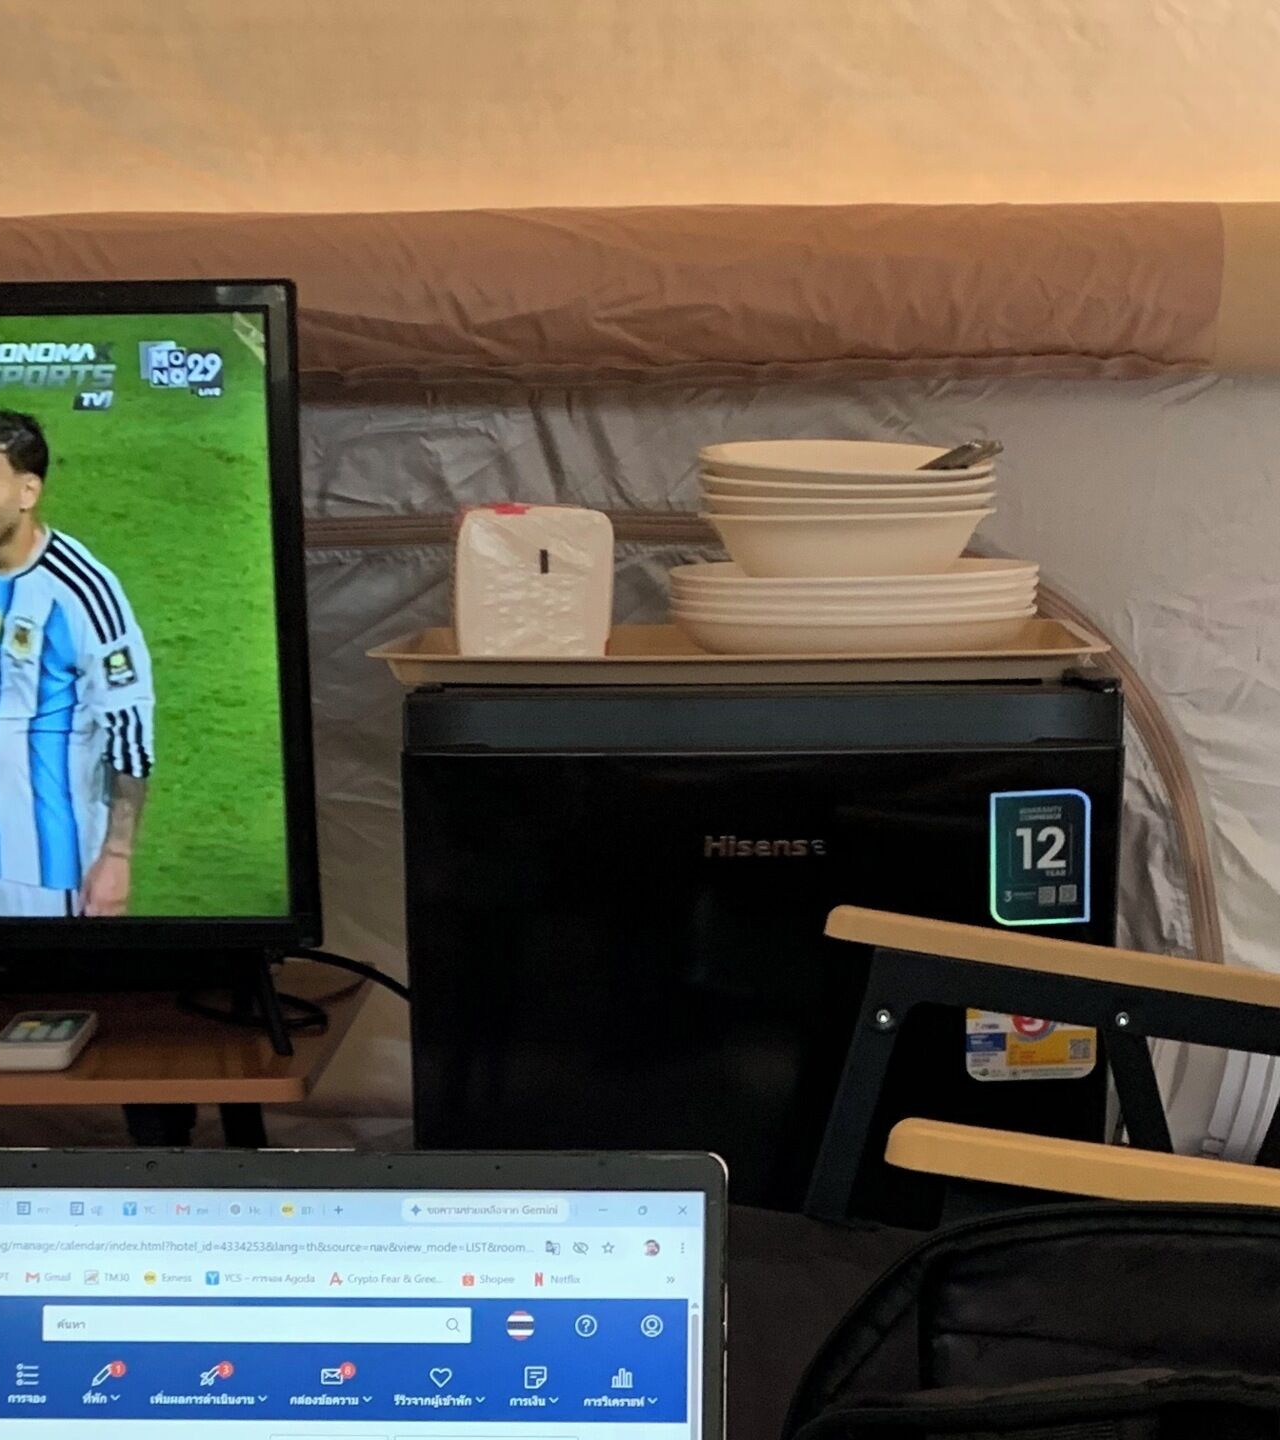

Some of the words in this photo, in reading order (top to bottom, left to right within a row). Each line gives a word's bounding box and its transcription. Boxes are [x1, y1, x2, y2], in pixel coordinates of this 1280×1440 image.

[187, 353, 222, 382] 29
[198, 388, 221, 396] LIVE
[704, 835, 827, 857] Hisense
[1015, 826, 1066, 870] 12
[1045, 869, 1067, 877] YEAR
[521, 1205, 558, 1216] Gemini
[44, 1272, 71, 1282] Gmail
[104, 1272, 130, 1282] TM30
[161, 1273, 192, 1283] Exness
[224, 1273, 242, 1283] YCS
[285, 1274, 315, 1285] Agoda
[347, 1274, 377, 1285] Crypto
[381, 1274, 400, 1284] Fear
[479, 1274, 515, 1286] Shopee
[550, 1274, 580, 1284] Netflix
[57, 1318, 86, 1330] ค้นหา
[7, 1393, 47, 1404] การจอง
[82, 1391, 108, 1404] ที่พัก
[289, 1393, 359, 1406] กล่องข้อความ
[394, 1394, 472, 1408] รีวิวจากผู้เข้าพัก
[509, 1394, 546, 1407] การเงิน
[583, 1396, 644, 1408] การวิเคราะห์
